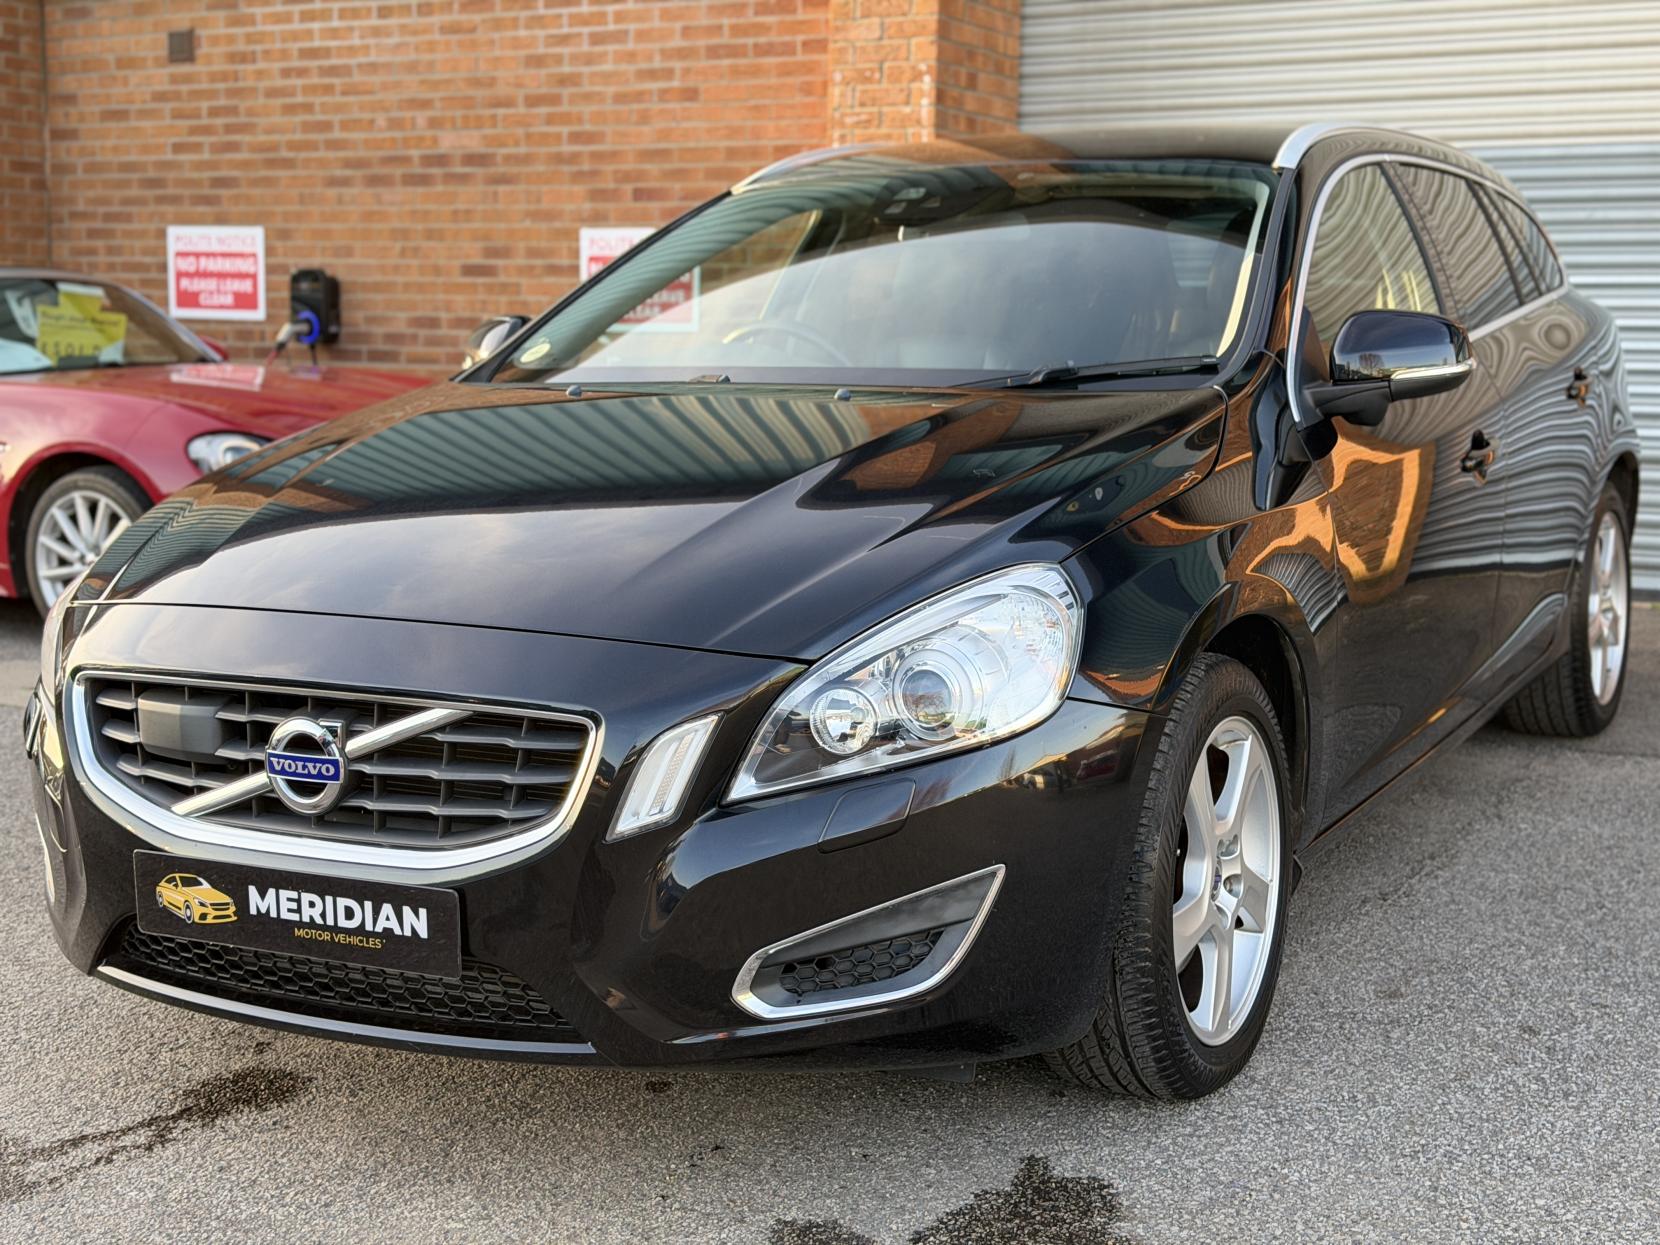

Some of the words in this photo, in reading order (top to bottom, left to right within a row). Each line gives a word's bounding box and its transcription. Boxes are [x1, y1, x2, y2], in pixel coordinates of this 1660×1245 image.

[176, 256, 197, 273] NO
[199, 256, 257, 274] PARKING
[179, 277, 217, 293] PLEASE
[219, 278, 254, 294] LEAVE
[198, 292, 235, 307] CLEAR
[269, 757, 336, 777] VOLVO
[247, 884, 428, 940] MERIDIAN
[294, 927, 331, 943] MOTOR
[333, 932, 382, 949] VEHICLES
